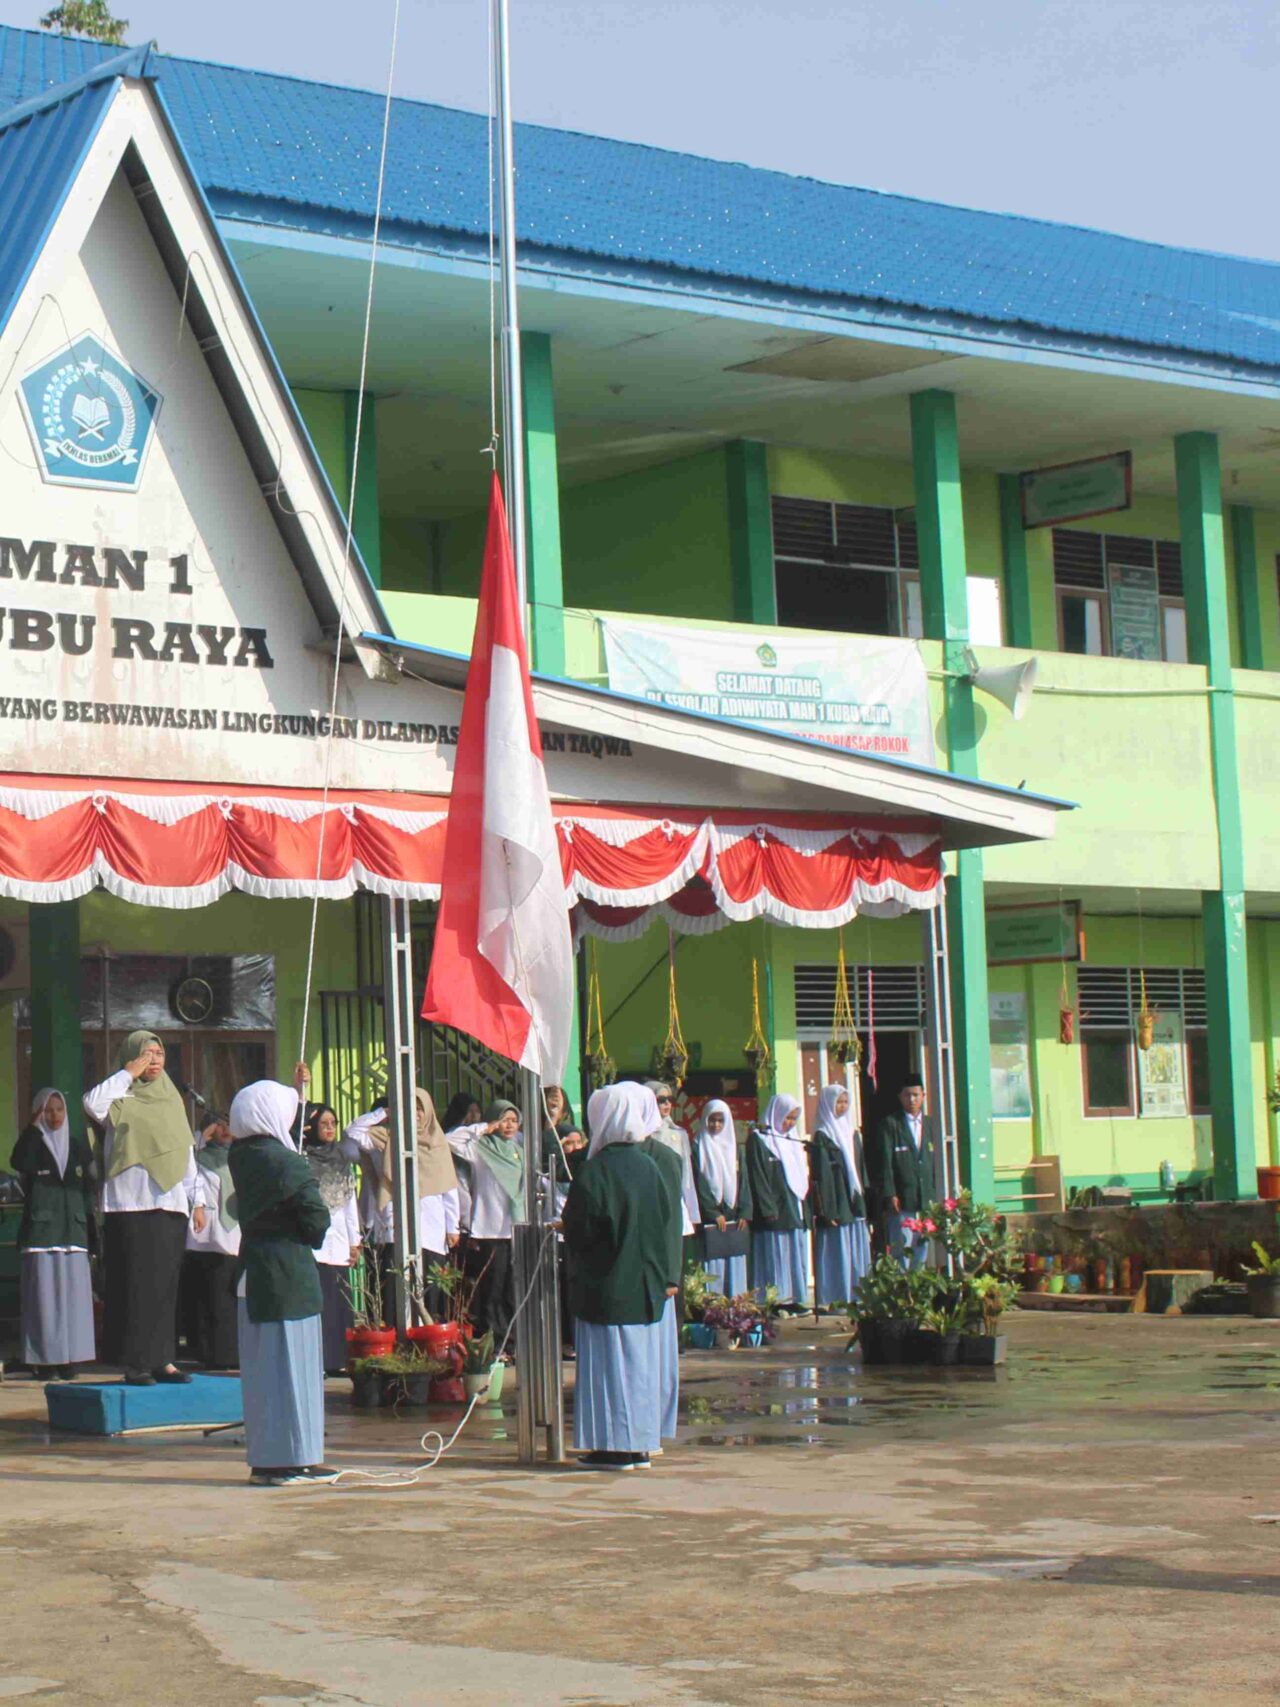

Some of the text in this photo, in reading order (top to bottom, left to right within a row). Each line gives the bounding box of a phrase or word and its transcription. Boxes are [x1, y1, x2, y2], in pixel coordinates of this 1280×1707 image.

[63, 441, 88, 463] IKHLAS
[169, 554, 193, 595] 1
[111, 617, 274, 669] RAYA
[718, 673, 821, 698] SELAMAT DATANG
[720, 697, 788, 719] ADIWIYATA
[789, 700, 817, 721] MAN
[826, 703, 859, 723] KUBU
[62, 700, 218, 731] BERWAWASAN
[221, 710, 358, 740] LINGKUNGAN
[362, 718, 460, 745] DILANDAS
[567, 732, 633, 759] TAQWA
[874, 735, 909, 752] ROKOK
